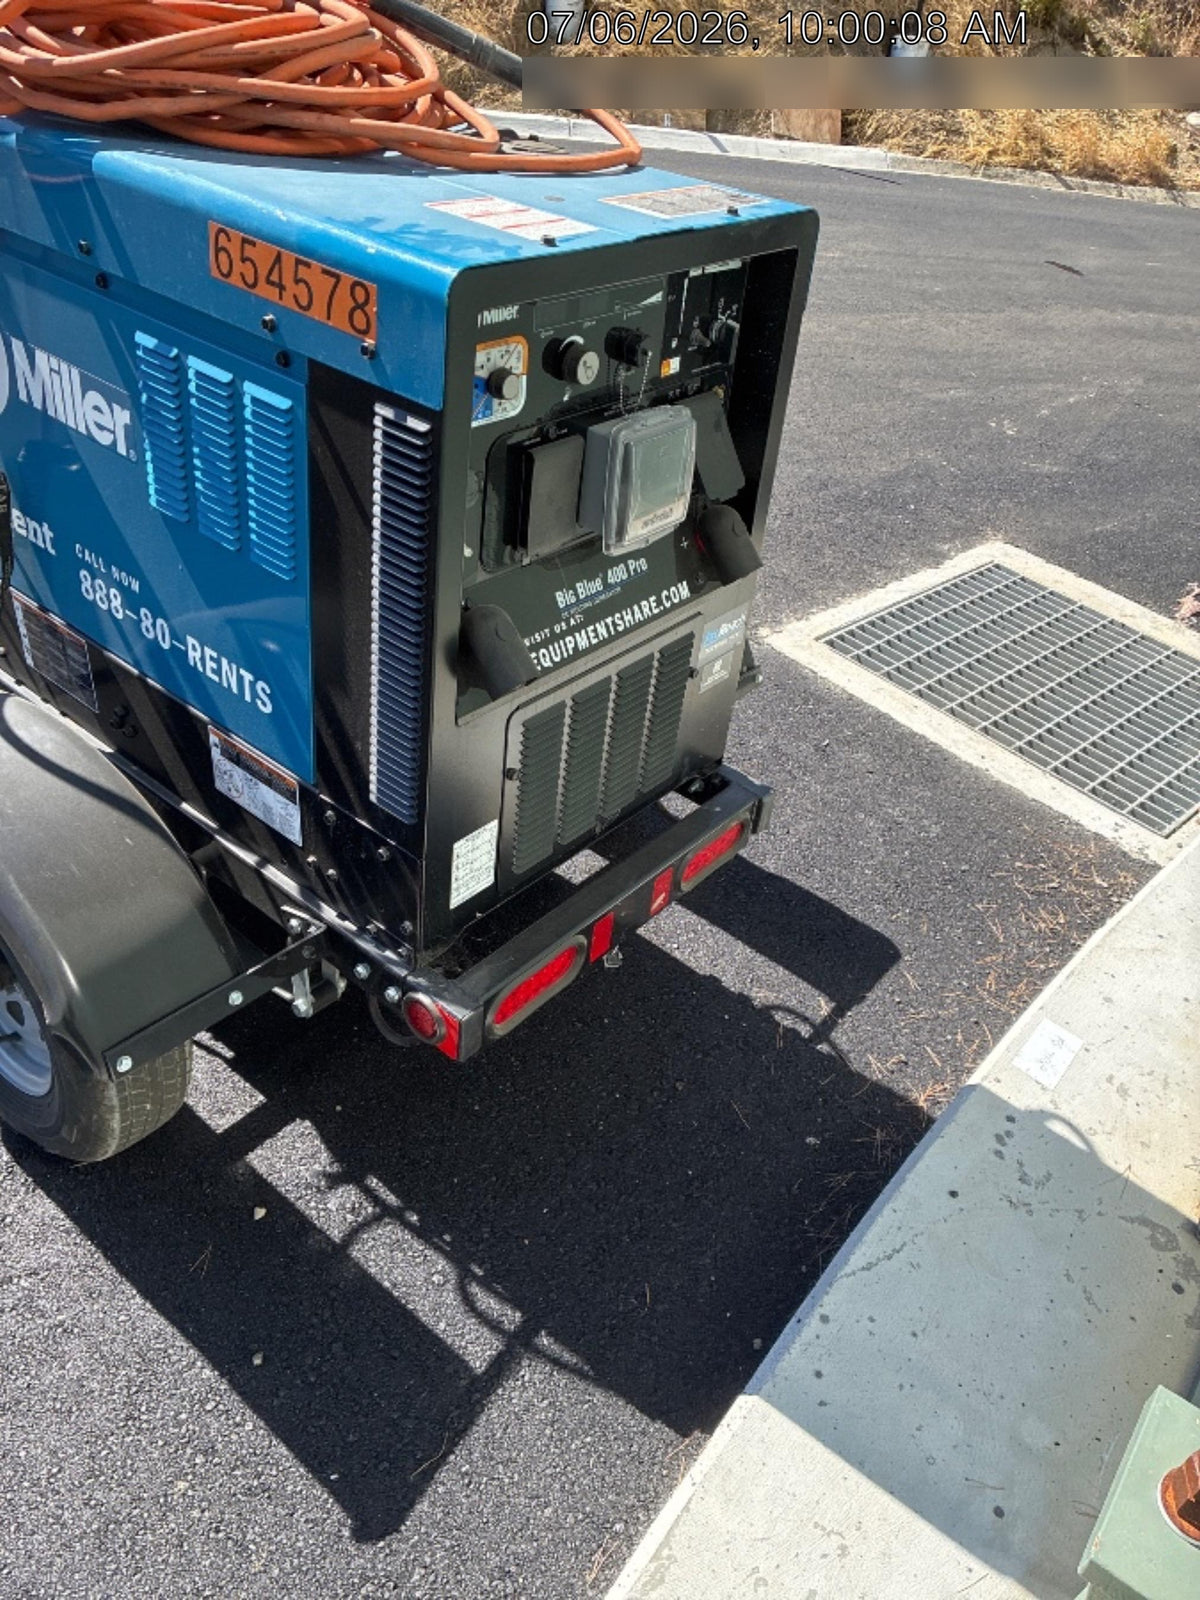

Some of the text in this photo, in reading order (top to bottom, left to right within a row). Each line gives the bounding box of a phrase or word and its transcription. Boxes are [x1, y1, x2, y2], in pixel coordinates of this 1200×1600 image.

[214, 227, 371, 336] 654578
[483, 305, 520, 326] Miller
[10, 336, 131, 457] Miller
[75, 543, 140, 594] CALL NOW
[555, 588, 577, 609] Big
[607, 563, 629, 585] 400
[627, 557, 649, 576] Pro
[79, 569, 273, 714] 888-80-RENTS
[523, 628, 551, 647] VISIT
[554, 621, 568, 634] US
[529, 580, 691, 671] EQUIPMENTSHARE.COM
